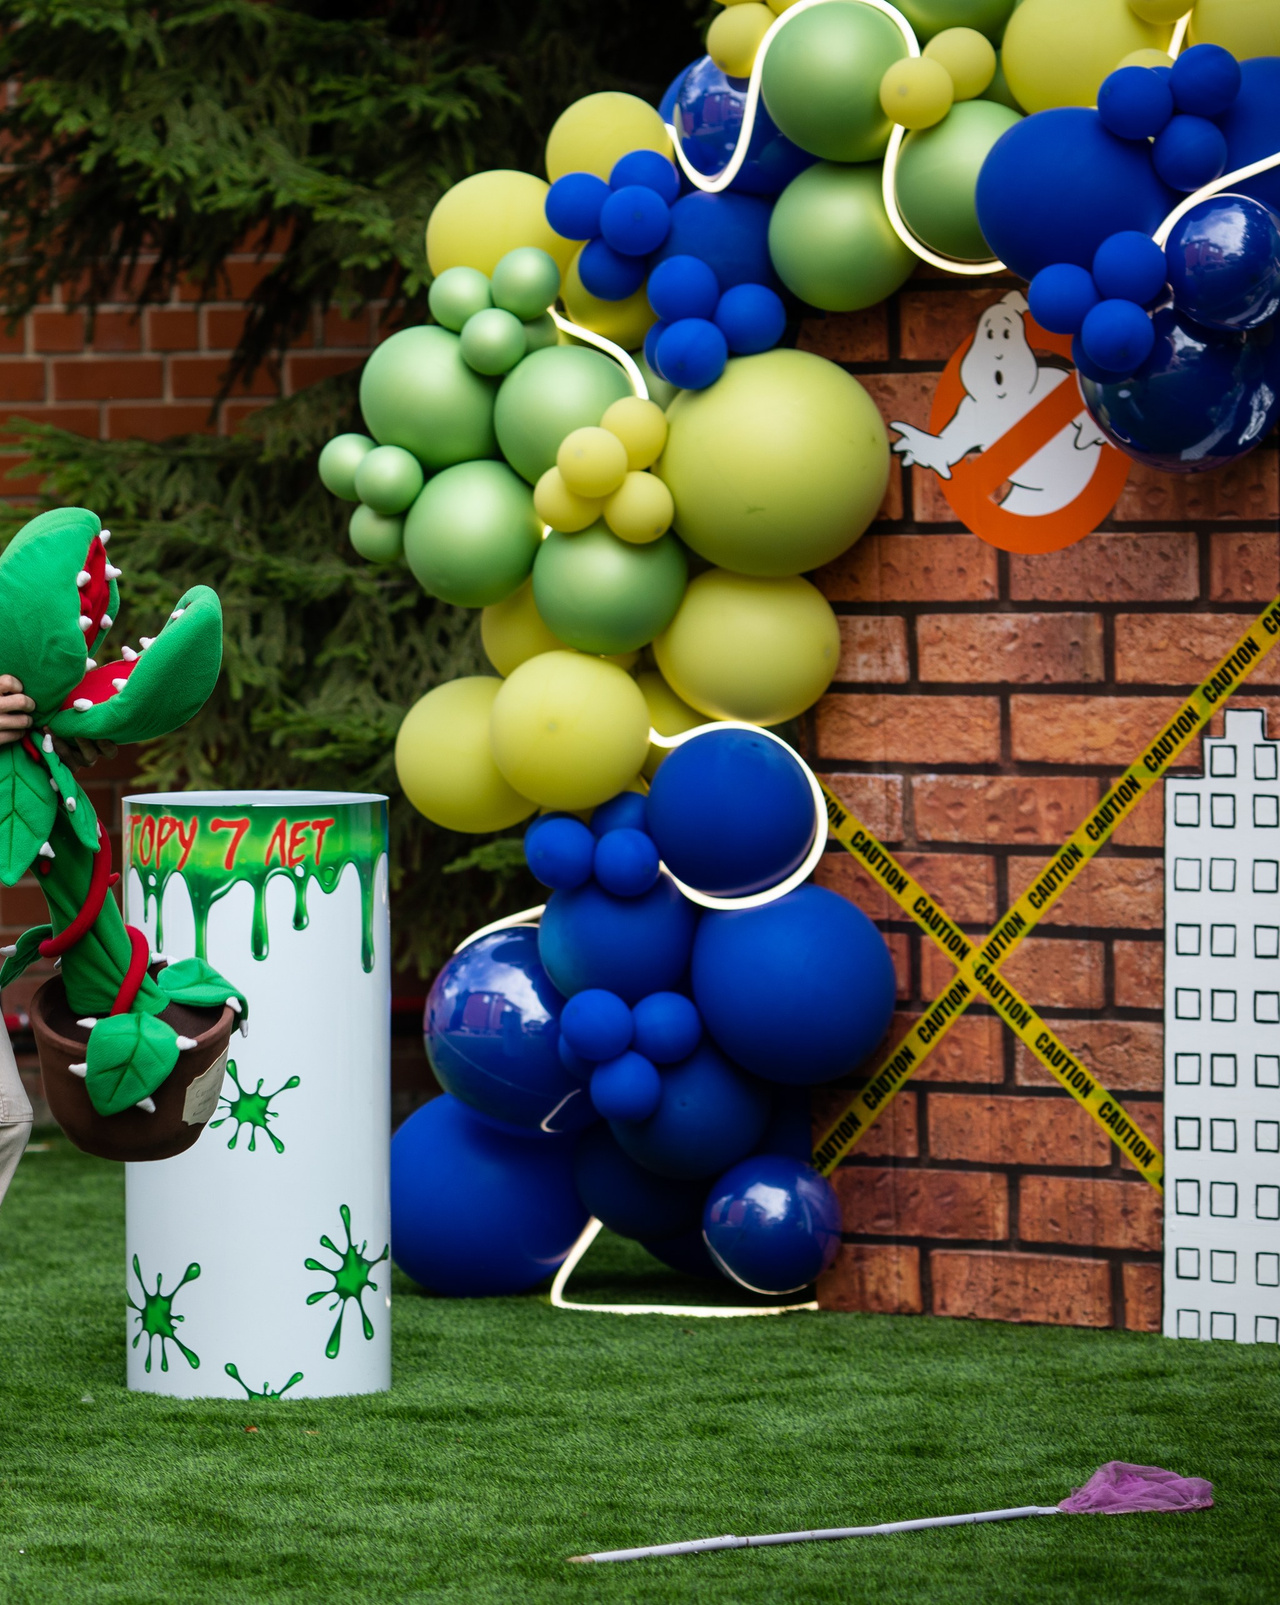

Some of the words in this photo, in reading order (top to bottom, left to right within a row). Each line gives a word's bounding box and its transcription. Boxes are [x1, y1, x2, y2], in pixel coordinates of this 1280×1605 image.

[210, 818, 250, 870] 7
[265, 818, 335, 868] ЛЕТ
[850, 831, 909, 894] CAUTION
[913, 897, 971, 961] CAUTION
[974, 964, 1032, 1029] CAUTION
[1034, 1032, 1095, 1099] CAUTION
[1097, 1101, 1156, 1168] CAUTION
[862, 1045, 916, 1110] CAUTION
[917, 979, 971, 1044] CAUTION
[1027, 843, 1084, 909] CAUTION
[1085, 775, 1142, 841] CAUTION
[1143, 705, 1200, 773] CAUTION
[1202, 636, 1260, 704] CAUTION
